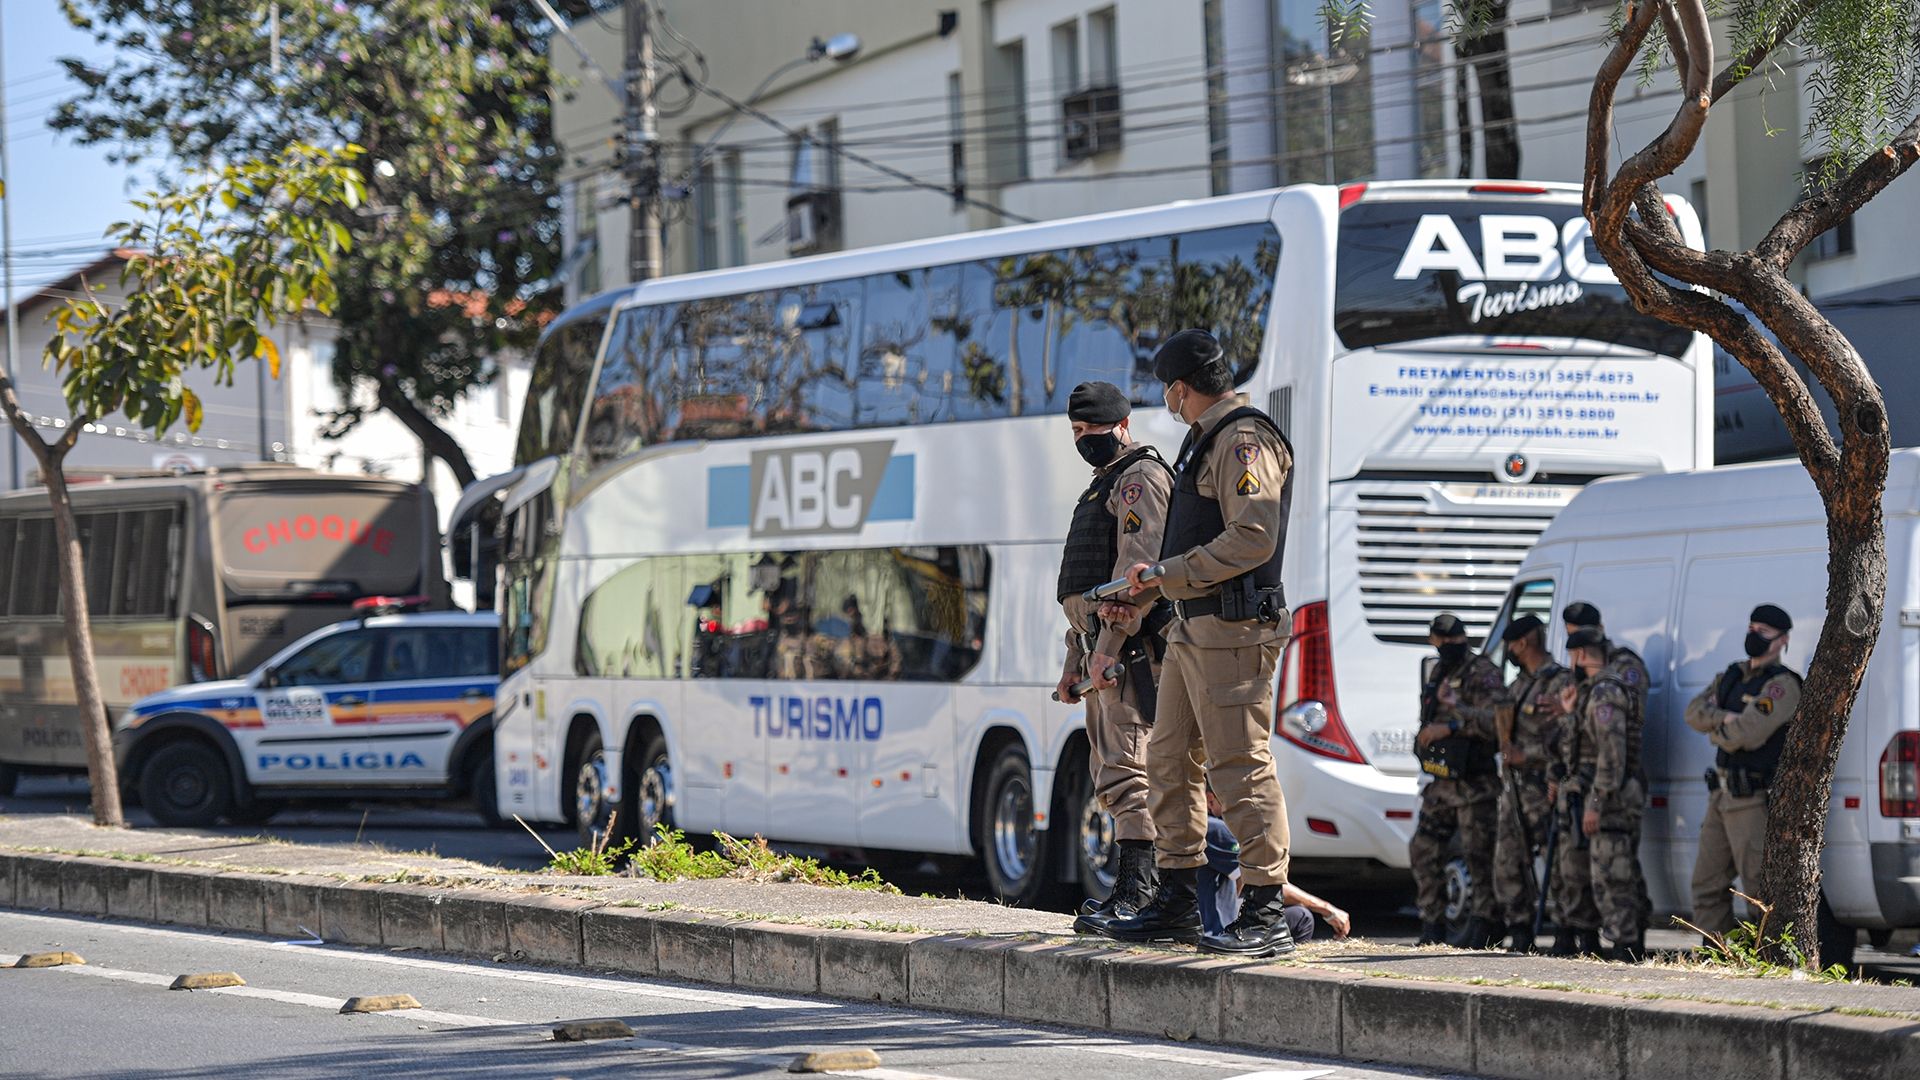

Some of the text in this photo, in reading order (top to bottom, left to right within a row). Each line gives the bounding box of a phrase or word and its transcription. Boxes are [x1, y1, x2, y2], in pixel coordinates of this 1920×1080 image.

[1456, 281, 1583, 324] Turismo
[1369, 383, 1423, 397] E-mail:
[1419, 404, 1497, 418] TURISMO:
[1413, 424, 1619, 440] www.abcturismobh.com.br
[754, 448, 862, 532] ABC
[242, 514, 395, 556] CHOQUE
[748, 696, 884, 743] TURISMO
[257, 751, 425, 771] POLÍCIA
